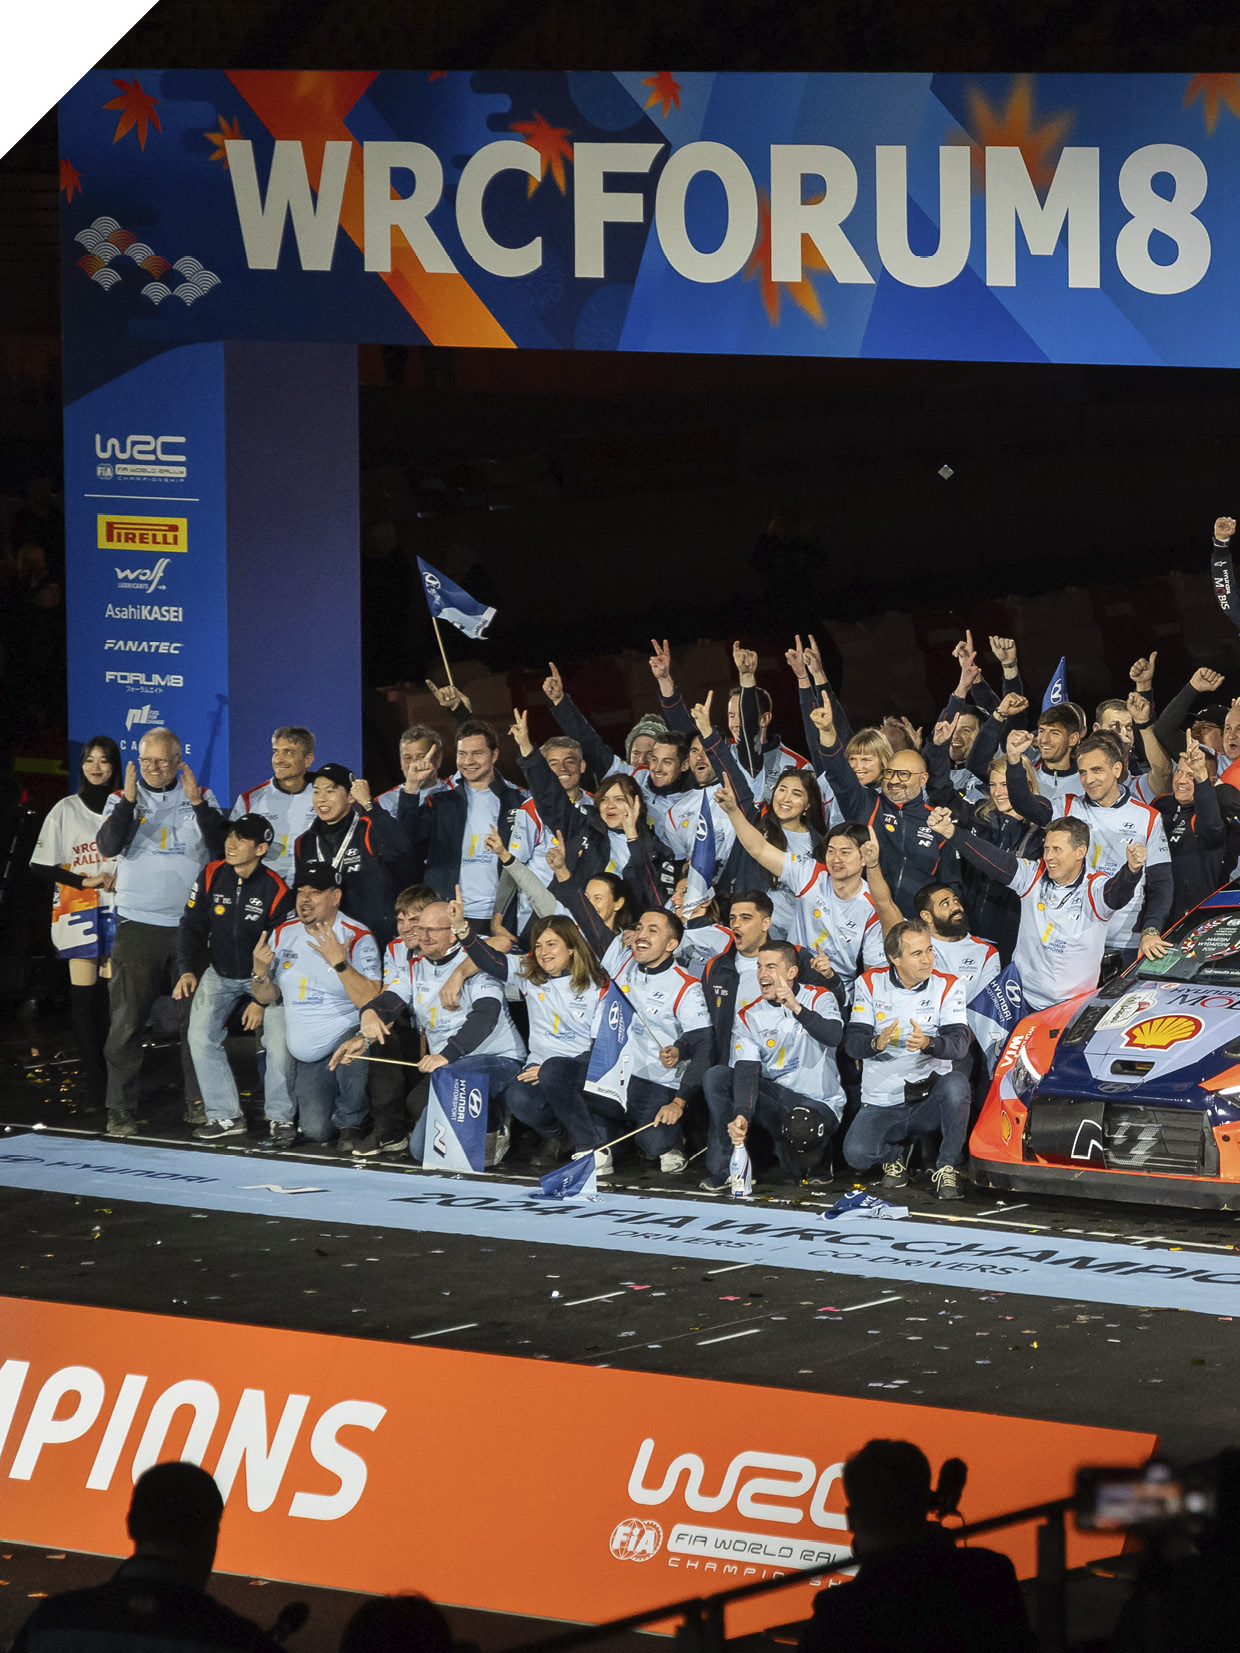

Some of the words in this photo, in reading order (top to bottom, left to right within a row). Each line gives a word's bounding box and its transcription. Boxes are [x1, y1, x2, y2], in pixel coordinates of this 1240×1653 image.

[95, 433, 187, 462] WRC
[106, 521, 179, 546] PIRELLI
[1213, 577, 1231, 611] MOBIS
[105, 603, 183, 622] AsahiKASEI
[104, 640, 184, 654] FANATEC
[105, 671, 184, 687] FORUM8
[990, 980, 1013, 1021] HYUNDAI
[451, 1078, 459, 1122] MOTORSPORT
[457, 1079, 467, 1123] HYUNDAI
[43, 1161, 220, 1184] HYUNDAI
[389, 1192, 587, 1217] 2024
[574, 1207, 700, 1229] FIA
[702, 1218, 897, 1246] WRC
[807, 1249, 1030, 1276] CO-DRIVERS'
[675, 1533, 708, 1548] FIA
[714, 1536, 794, 1559] WORLD
